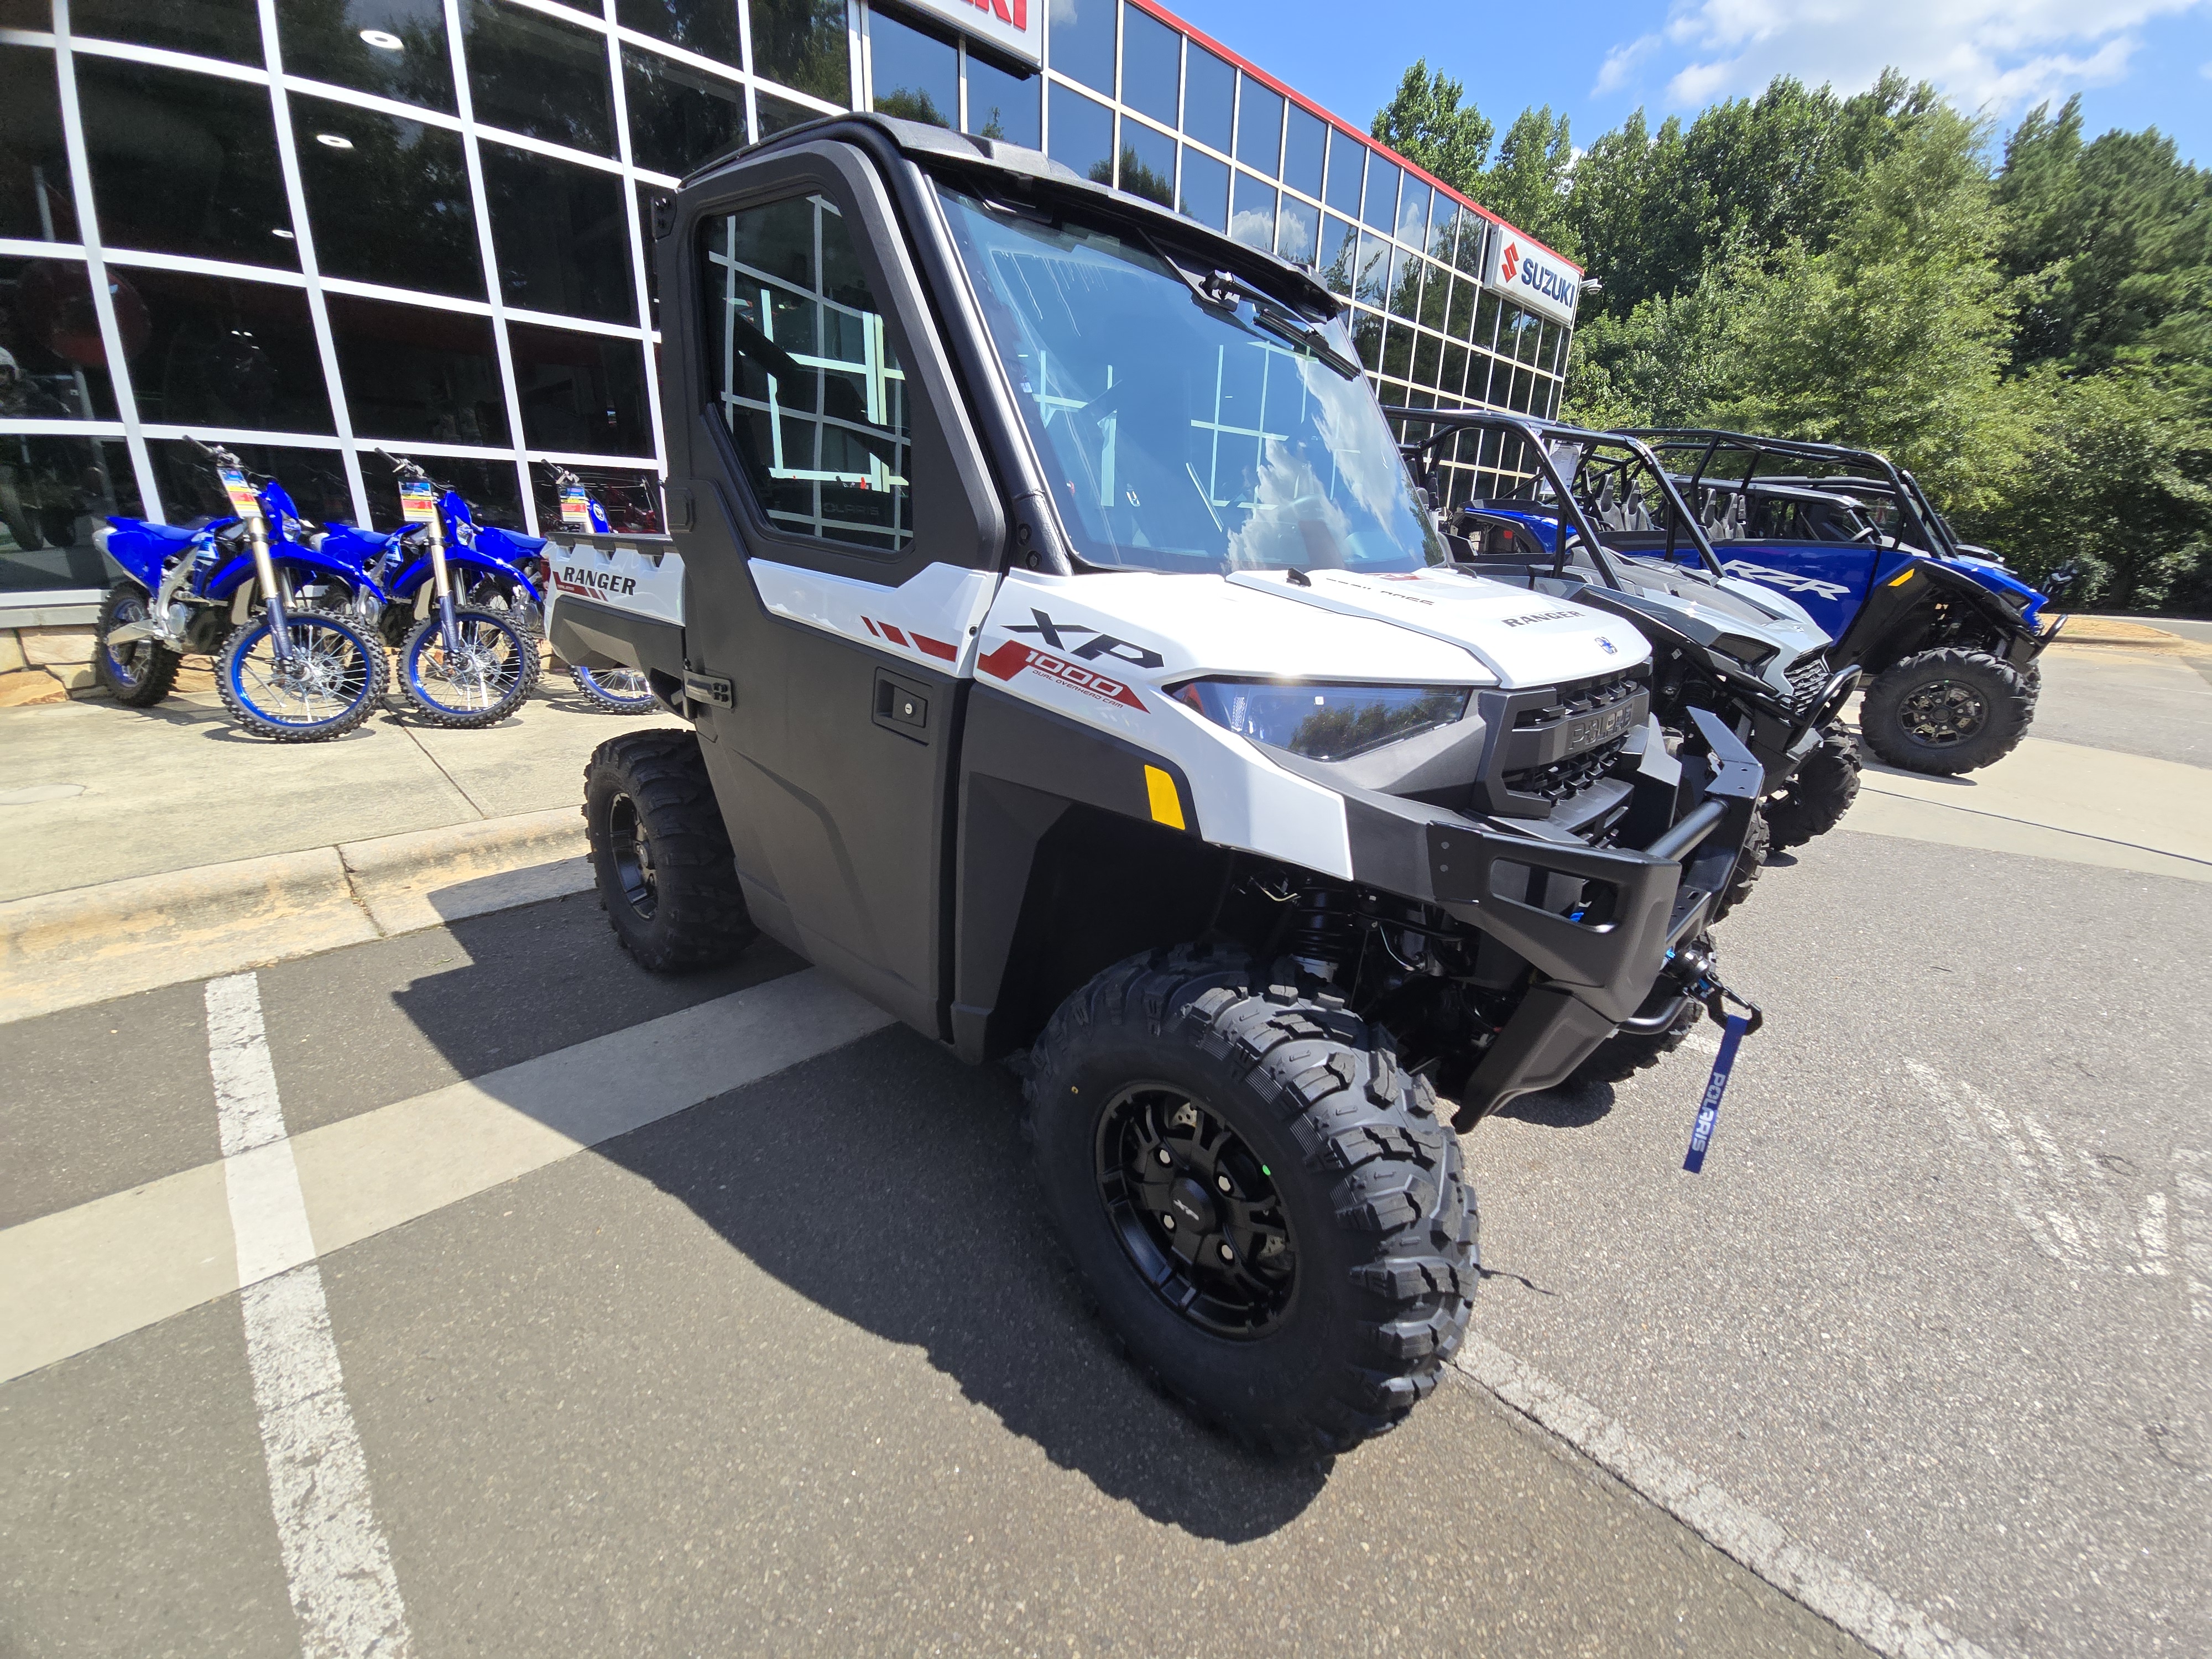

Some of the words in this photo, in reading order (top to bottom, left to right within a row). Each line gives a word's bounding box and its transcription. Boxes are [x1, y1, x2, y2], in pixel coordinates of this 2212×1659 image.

[1521, 258, 1576, 309] SUZUKI
[563, 566, 637, 596] RANGER
[1721, 559, 1851, 601] RZR
[999, 607, 1165, 669] XP
[1501, 611, 1587, 628] RANGER
[1025, 650, 1124, 697] 1000
[1032, 669, 1053, 681] DUAL
[1055, 679, 1102, 700] OVERHEAD
[1102, 698, 1124, 708] CAM
[1568, 703, 1632, 750] POLARIS
[1692, 1072, 1726, 1152] POLARIS
